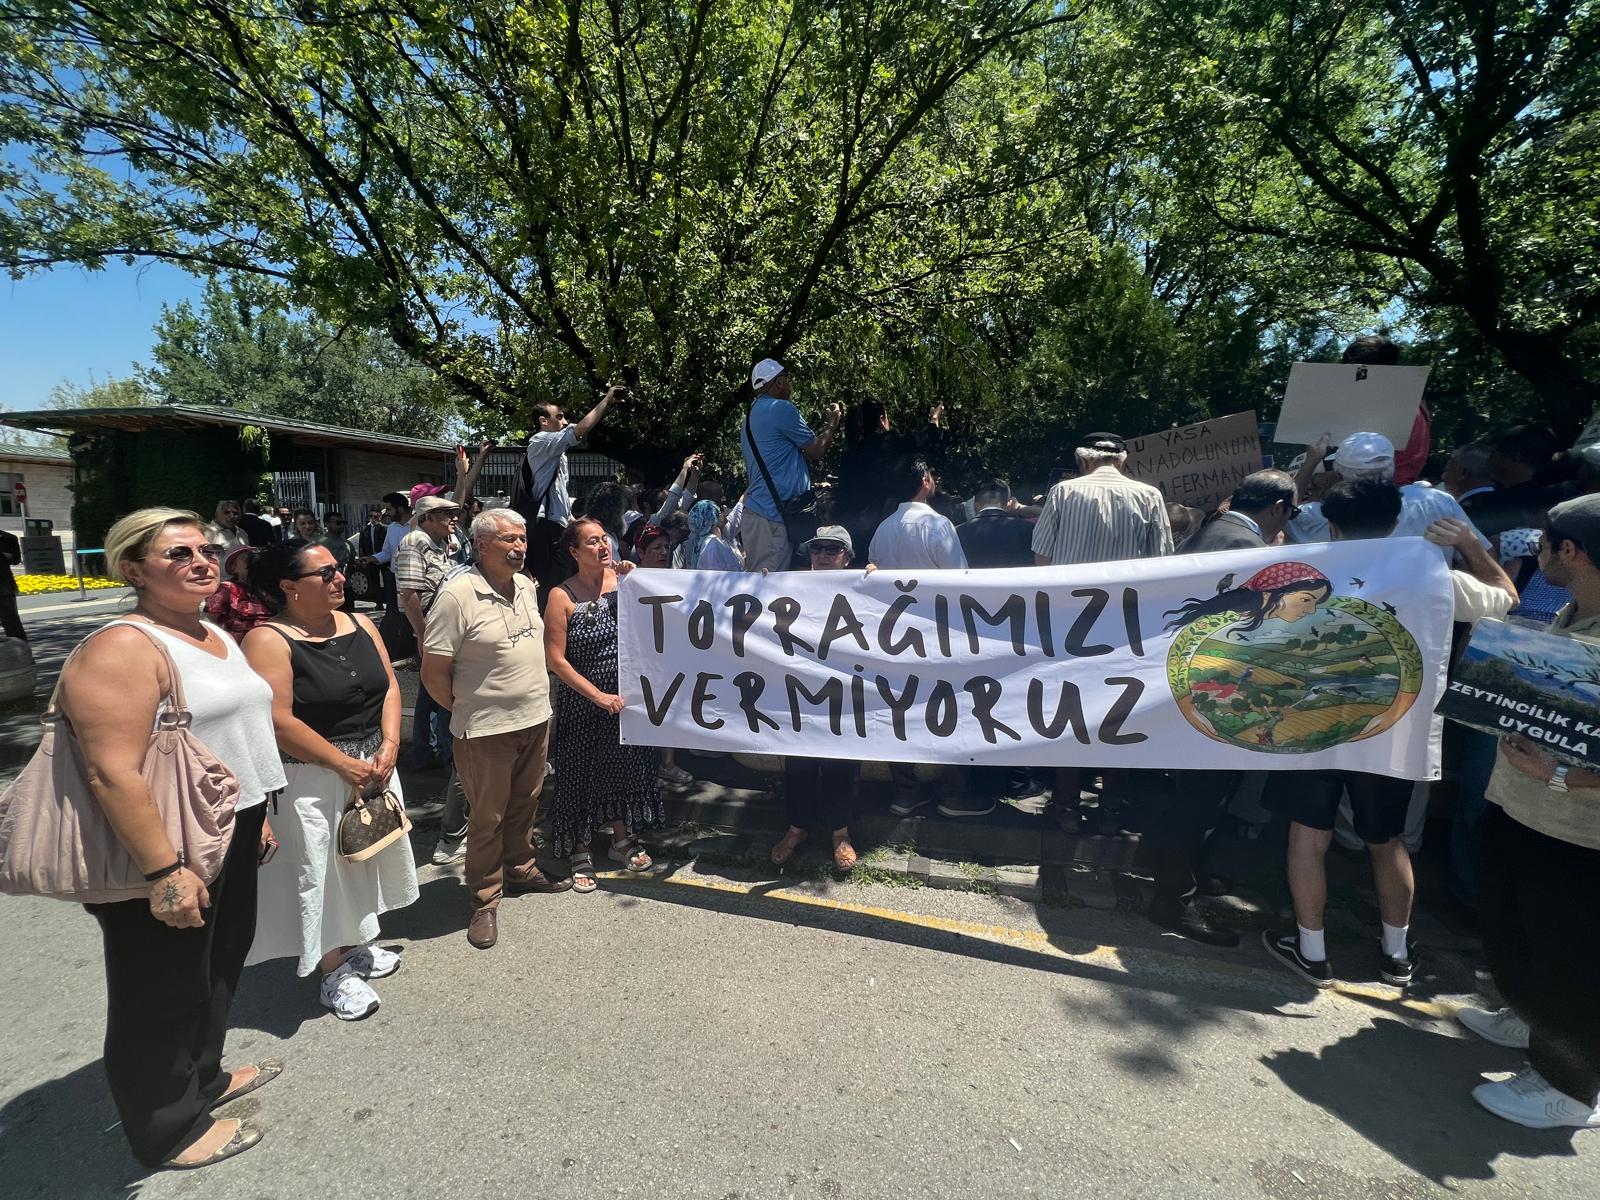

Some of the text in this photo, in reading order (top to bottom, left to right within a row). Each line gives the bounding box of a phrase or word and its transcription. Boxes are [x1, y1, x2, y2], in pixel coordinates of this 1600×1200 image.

[1124, 435, 1257, 477] ANADOLUNUN
[1160, 424, 1211, 447] YASA
[638, 579, 1145, 661] TOPRAĞIMIZI
[639, 664, 1149, 746] VERMİYORUZ
[1449, 681, 1571, 728] ZEYTİNCİLİK
[1498, 715, 1587, 756] UYGULA
